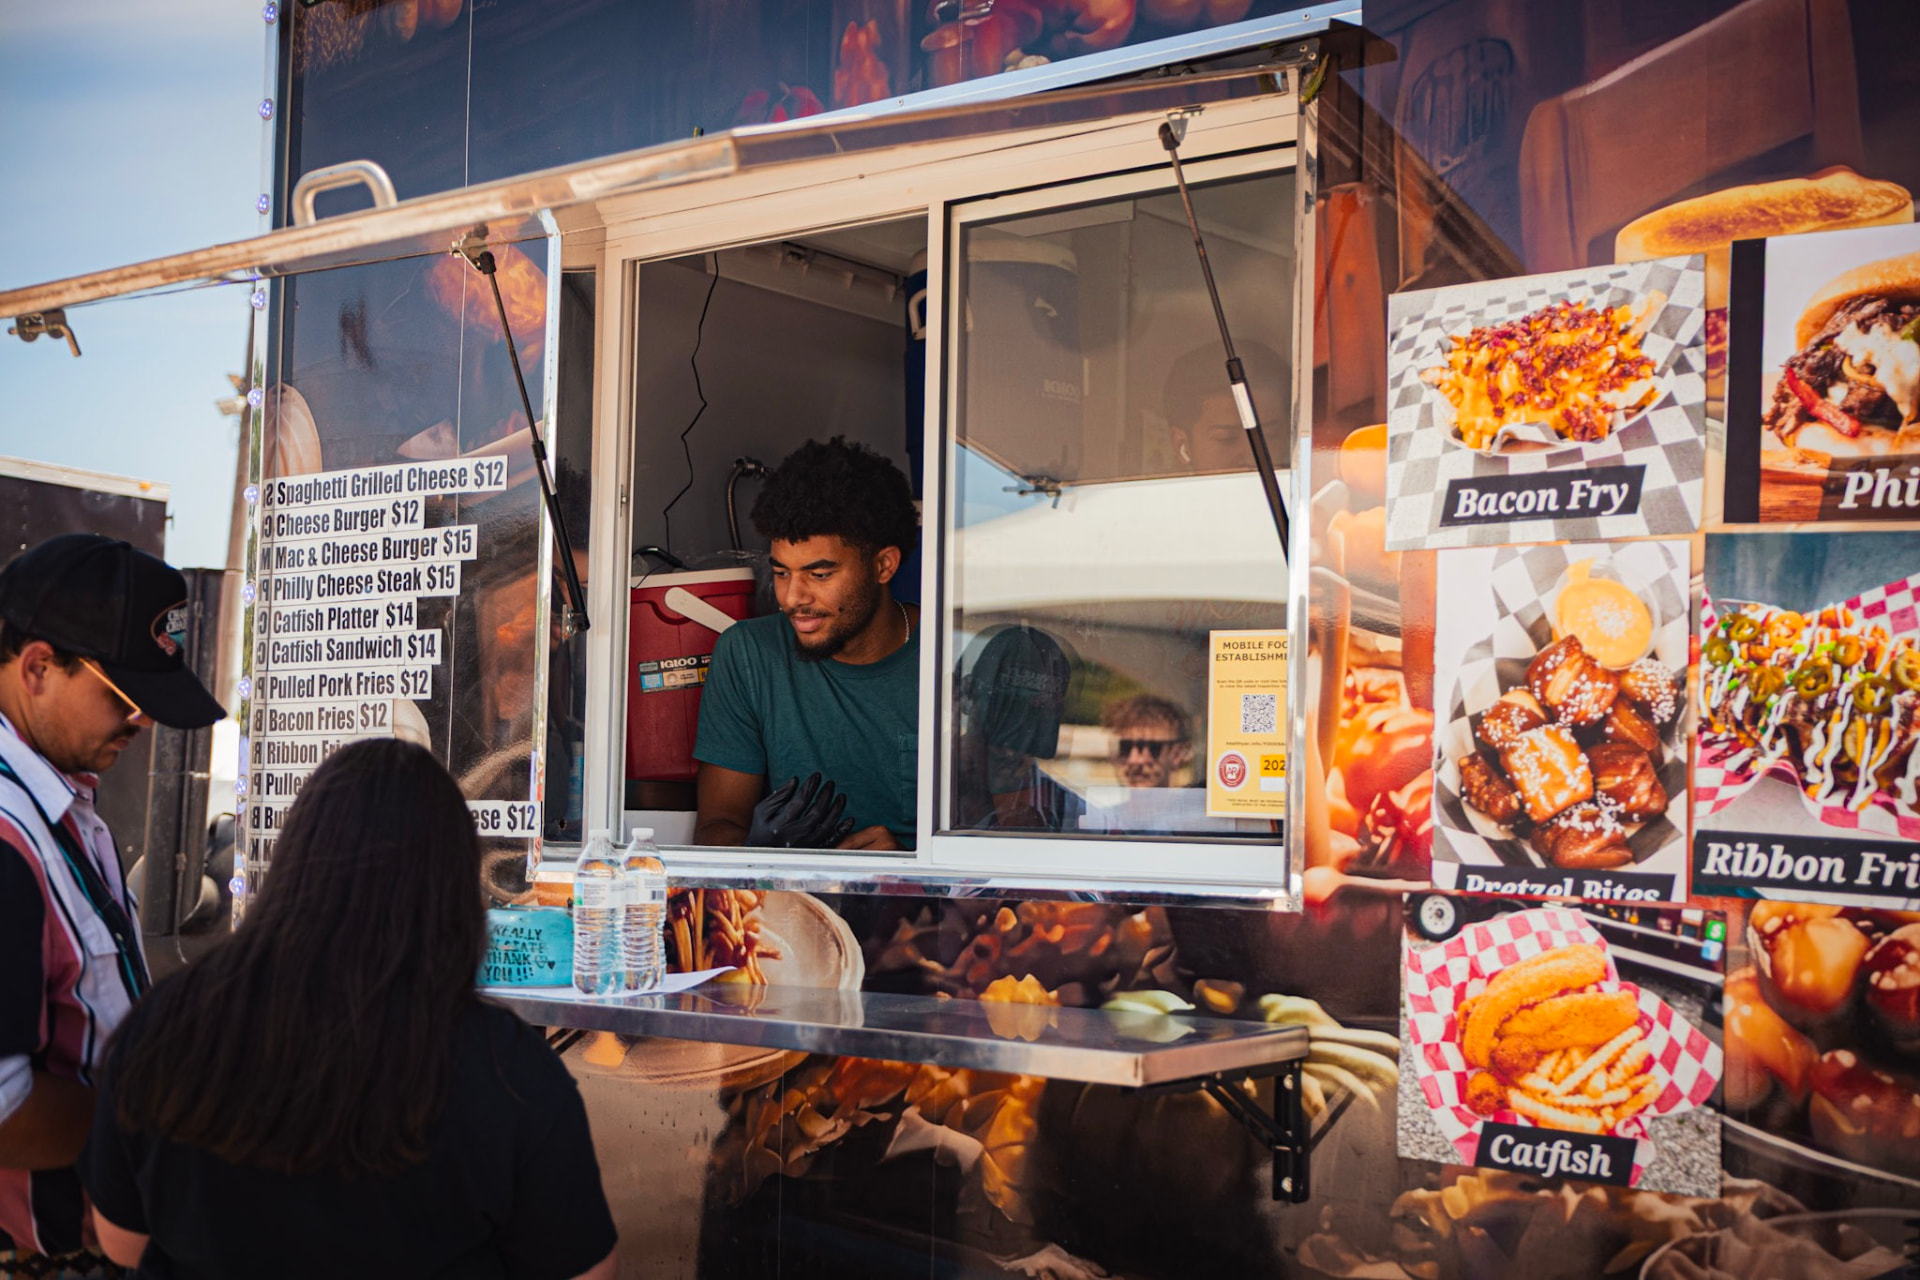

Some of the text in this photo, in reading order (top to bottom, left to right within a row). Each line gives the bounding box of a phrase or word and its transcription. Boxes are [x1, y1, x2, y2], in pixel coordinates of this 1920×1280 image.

[277, 460, 505, 506] Spaghetti Grilled Cheese $12
[1453, 479, 1629, 518] Bacon Fry
[1838, 466, 1920, 509] Phi
[276, 499, 419, 538] Cheese Burger $12
[275, 528, 472, 570] Mac & Cheese Burger $15
[273, 564, 456, 602] Philly Cheese Steak $15
[272, 601, 414, 634] Catfish Platter $14
[271, 632, 436, 665] Catfish Sandwich $14
[1222, 640, 1288, 650] MOBILE FOO
[660, 657, 698, 669] IGLOO
[269, 668, 429, 699] Pulled Pork Fries $12
[268, 702, 388, 732] Bacon Fries $12
[267, 741, 318, 765] Ribbon
[470, 808, 501, 830] ese
[507, 803, 536, 833] $12
[1701, 842, 1847, 883] Ribbon
[487, 951, 532, 966] THANK
[1490, 1134, 1612, 1178] Catfish
